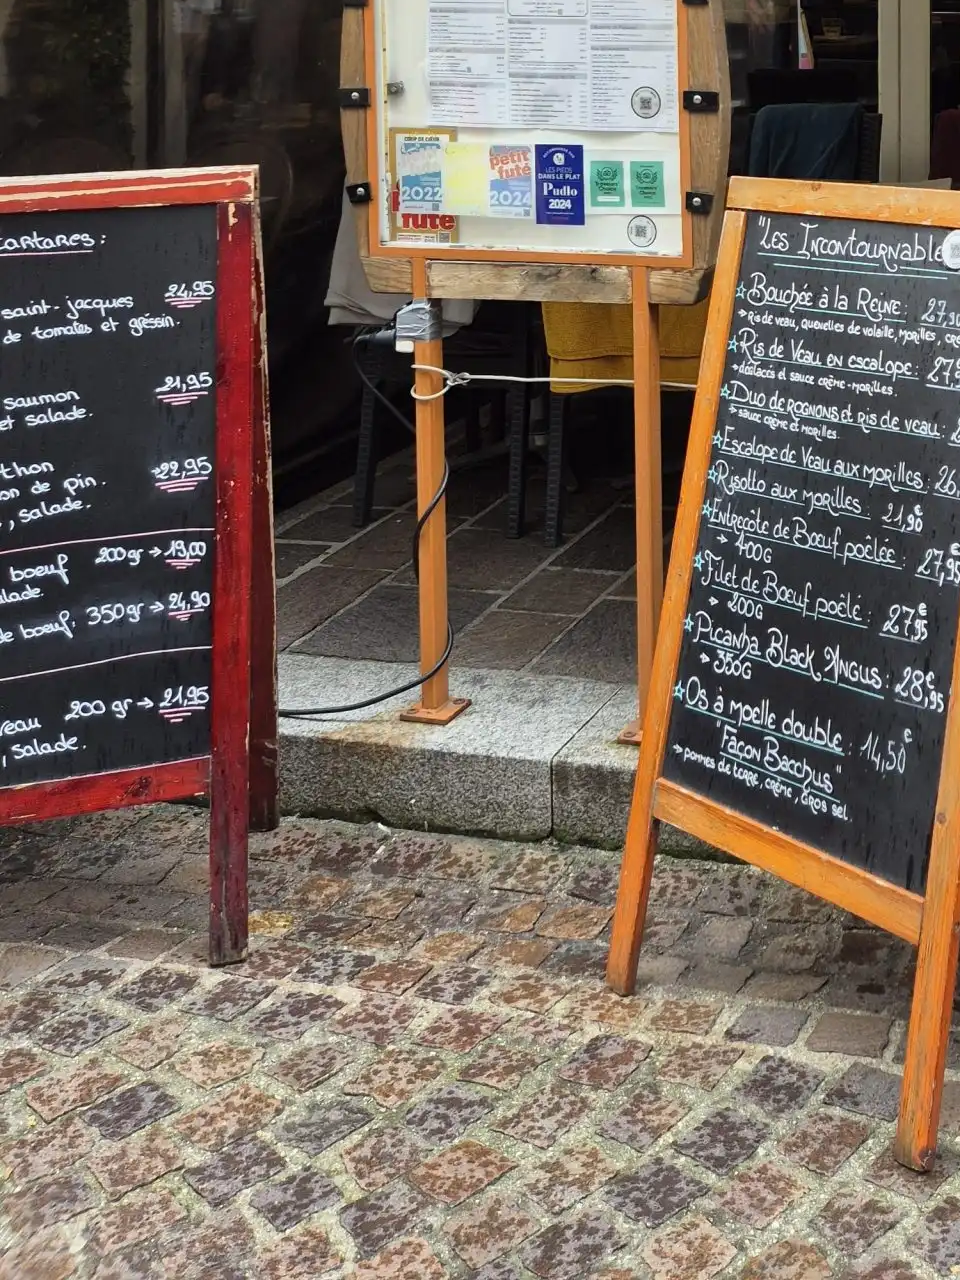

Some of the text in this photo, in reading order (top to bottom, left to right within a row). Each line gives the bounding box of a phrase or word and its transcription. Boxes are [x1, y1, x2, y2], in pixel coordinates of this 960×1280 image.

[489, 151, 530, 170] petit
[402, 186, 442, 200] 2022
[490, 191, 531, 206] 2024
[543, 182, 578, 196] Pudlo
[548, 199, 572, 210] 2024
[797, 222, 945, 272] Incontournable
[165, 280, 215, 299] 24,95
[747, 271, 813, 313] Bouchée
[818, 287, 829, 308] à
[834, 290, 848, 311] la
[3, 330, 22, 345] de
[32, 322, 93, 340] tomates
[101, 317, 119, 332] et
[761, 311, 773, 325] de
[848, 320, 861, 335] de
[738, 327, 765, 364] Ris
[769, 337, 784, 358] de
[791, 339, 822, 365] Veau
[155, 372, 213, 392] 21,95
[790, 372, 815, 385] sauce
[3, 390, 80, 410] saumon
[729, 381, 766, 409] Duo
[769, 395, 785, 412] de
[841, 406, 853, 422] et
[881, 411, 900, 428] de
[0, 406, 94, 431] et salade.
[738, 408, 761, 423] sauce
[790, 417, 800, 432] et
[721, 425, 779, 467] Escalope
[782, 444, 797, 464] de
[801, 446, 831, 475] Veau
[834, 463, 860, 478] aux
[0, 461, 55, 479] thon
[154, 457, 212, 480] 22,95
[714, 459, 766, 495] Risotto
[771, 484, 797, 501] aux
[31, 480, 51, 494] de
[709, 497, 770, 536] Entrecôte
[773, 518, 791, 538] de
[164, 540, 207, 560] 19,00
[701, 549, 740, 587] Filet
[741, 570, 759, 593] de
[168, 590, 211, 610] 24,90
[693, 610, 760, 661] Picanha
[766, 627, 822, 682] Black
[160, 686, 209, 707] 21,95
[685, 676, 709, 708] Os
[713, 687, 723, 713] à
[730, 699, 776, 730] moelle
[65, 700, 106, 721] 200
[112, 698, 133, 719] gr
[718, 757, 732, 775] de
